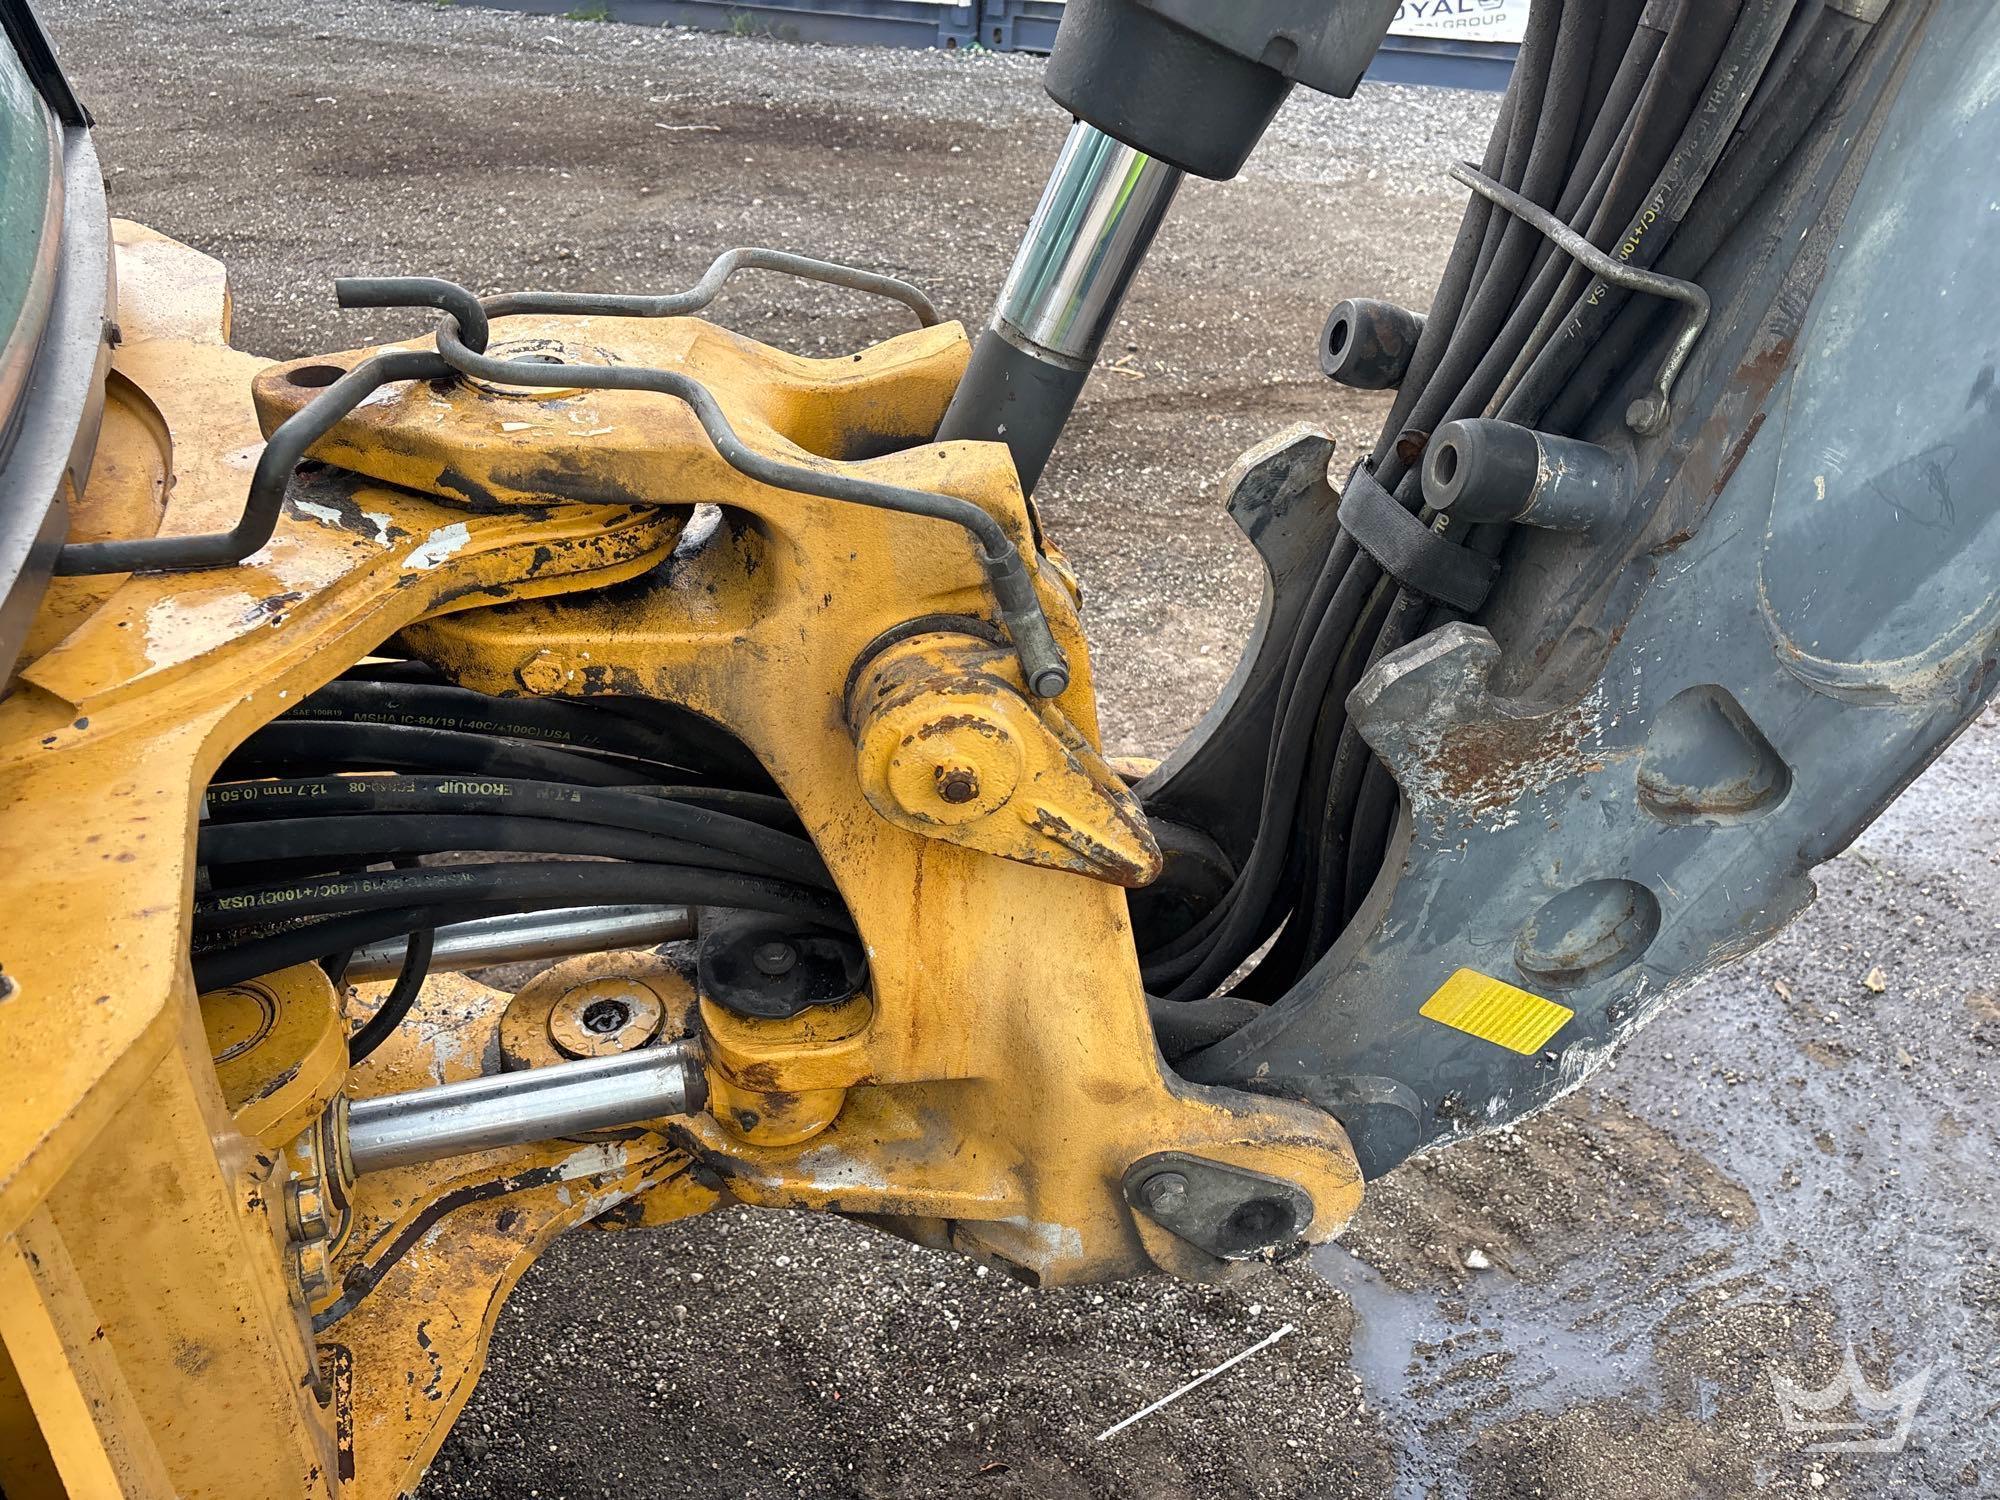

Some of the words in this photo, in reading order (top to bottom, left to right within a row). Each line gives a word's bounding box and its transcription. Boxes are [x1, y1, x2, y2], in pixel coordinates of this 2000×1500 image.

[1443, 13, 1506, 28] GROUP
[1586, 284, 1609, 306] SA
[353, 713, 397, 723] MSHA
[400, 715, 456, 729] IC-84/19
[543, 729, 572, 741] USA
[263, 786, 293, 796] mm
[297, 783, 327, 797] 12.7
[218, 894, 256, 911] USA
